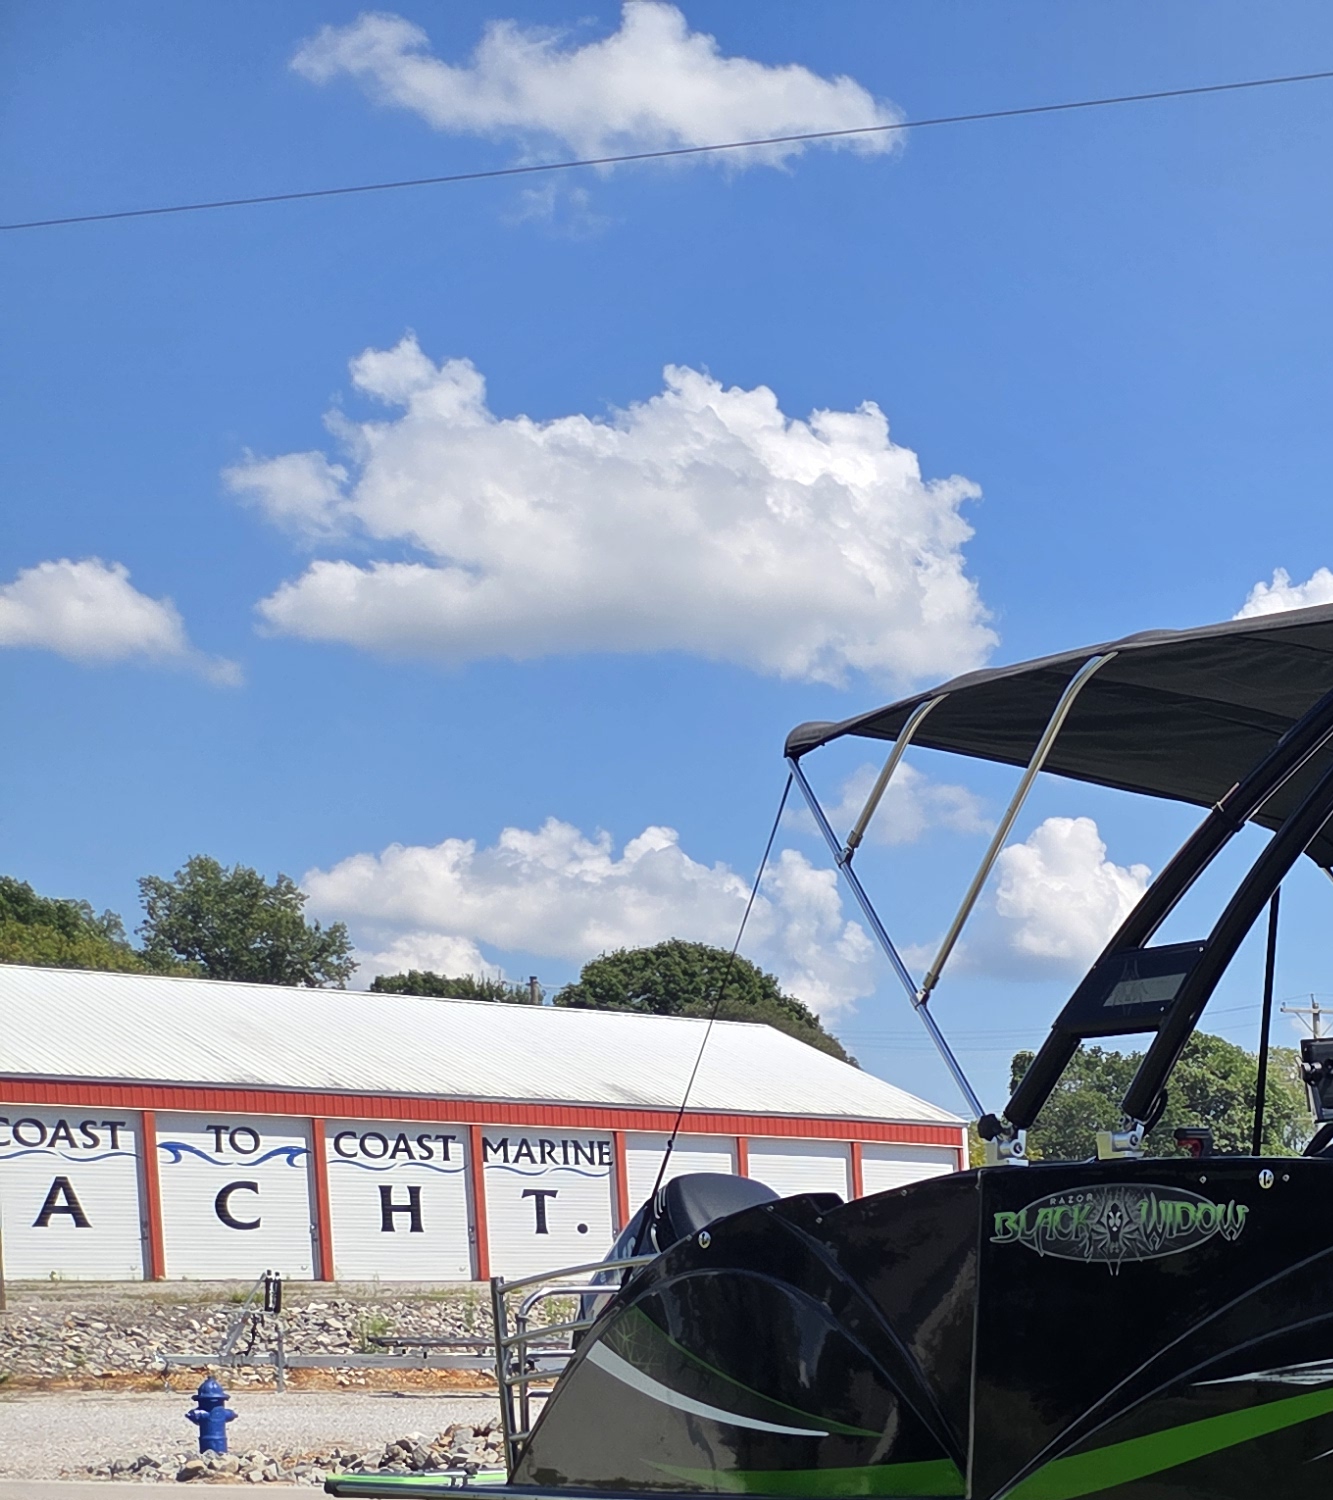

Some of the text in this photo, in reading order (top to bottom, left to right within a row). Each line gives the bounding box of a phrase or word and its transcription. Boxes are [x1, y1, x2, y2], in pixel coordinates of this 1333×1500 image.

[206, 1125, 260, 1154] TO
[333, 1131, 457, 1162] COAST
[482, 1136, 613, 1167] MARINE
[32, 1176, 93, 1228] A
[215, 1181, 261, 1230] C
[378, 1185, 425, 1233] H
[1050, 1193, 1093, 1205] RAZOR
[989, 1191, 1250, 1258] BLACK WIDOW
